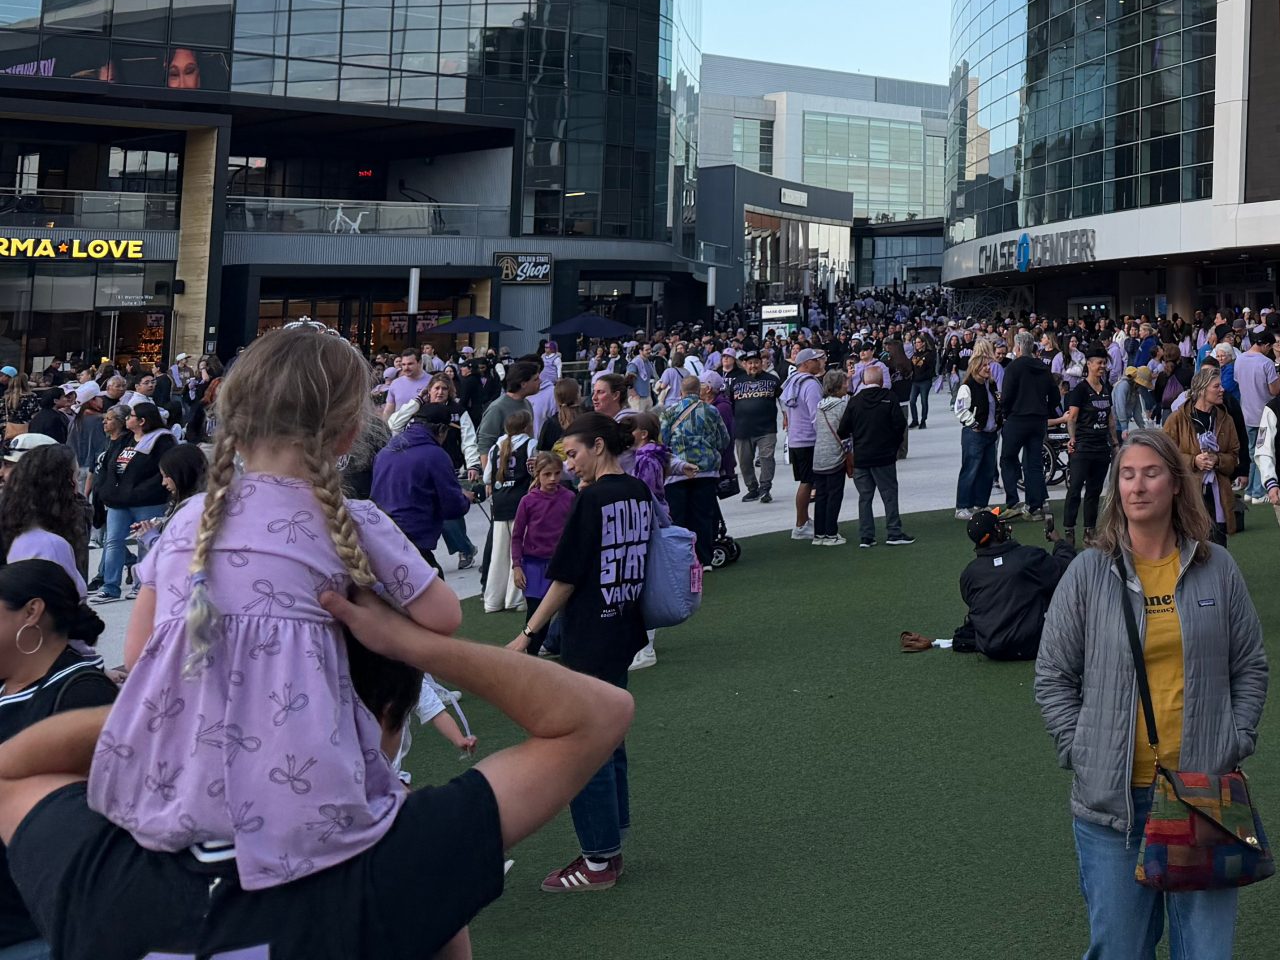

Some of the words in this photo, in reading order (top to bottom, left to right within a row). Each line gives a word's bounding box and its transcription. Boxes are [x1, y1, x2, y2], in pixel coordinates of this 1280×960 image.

[72, 239, 143, 258] LOVE
[979, 240, 1018, 273] CHASE
[1031, 229, 1096, 267] CENTER
[517, 262, 550, 281] Shop
